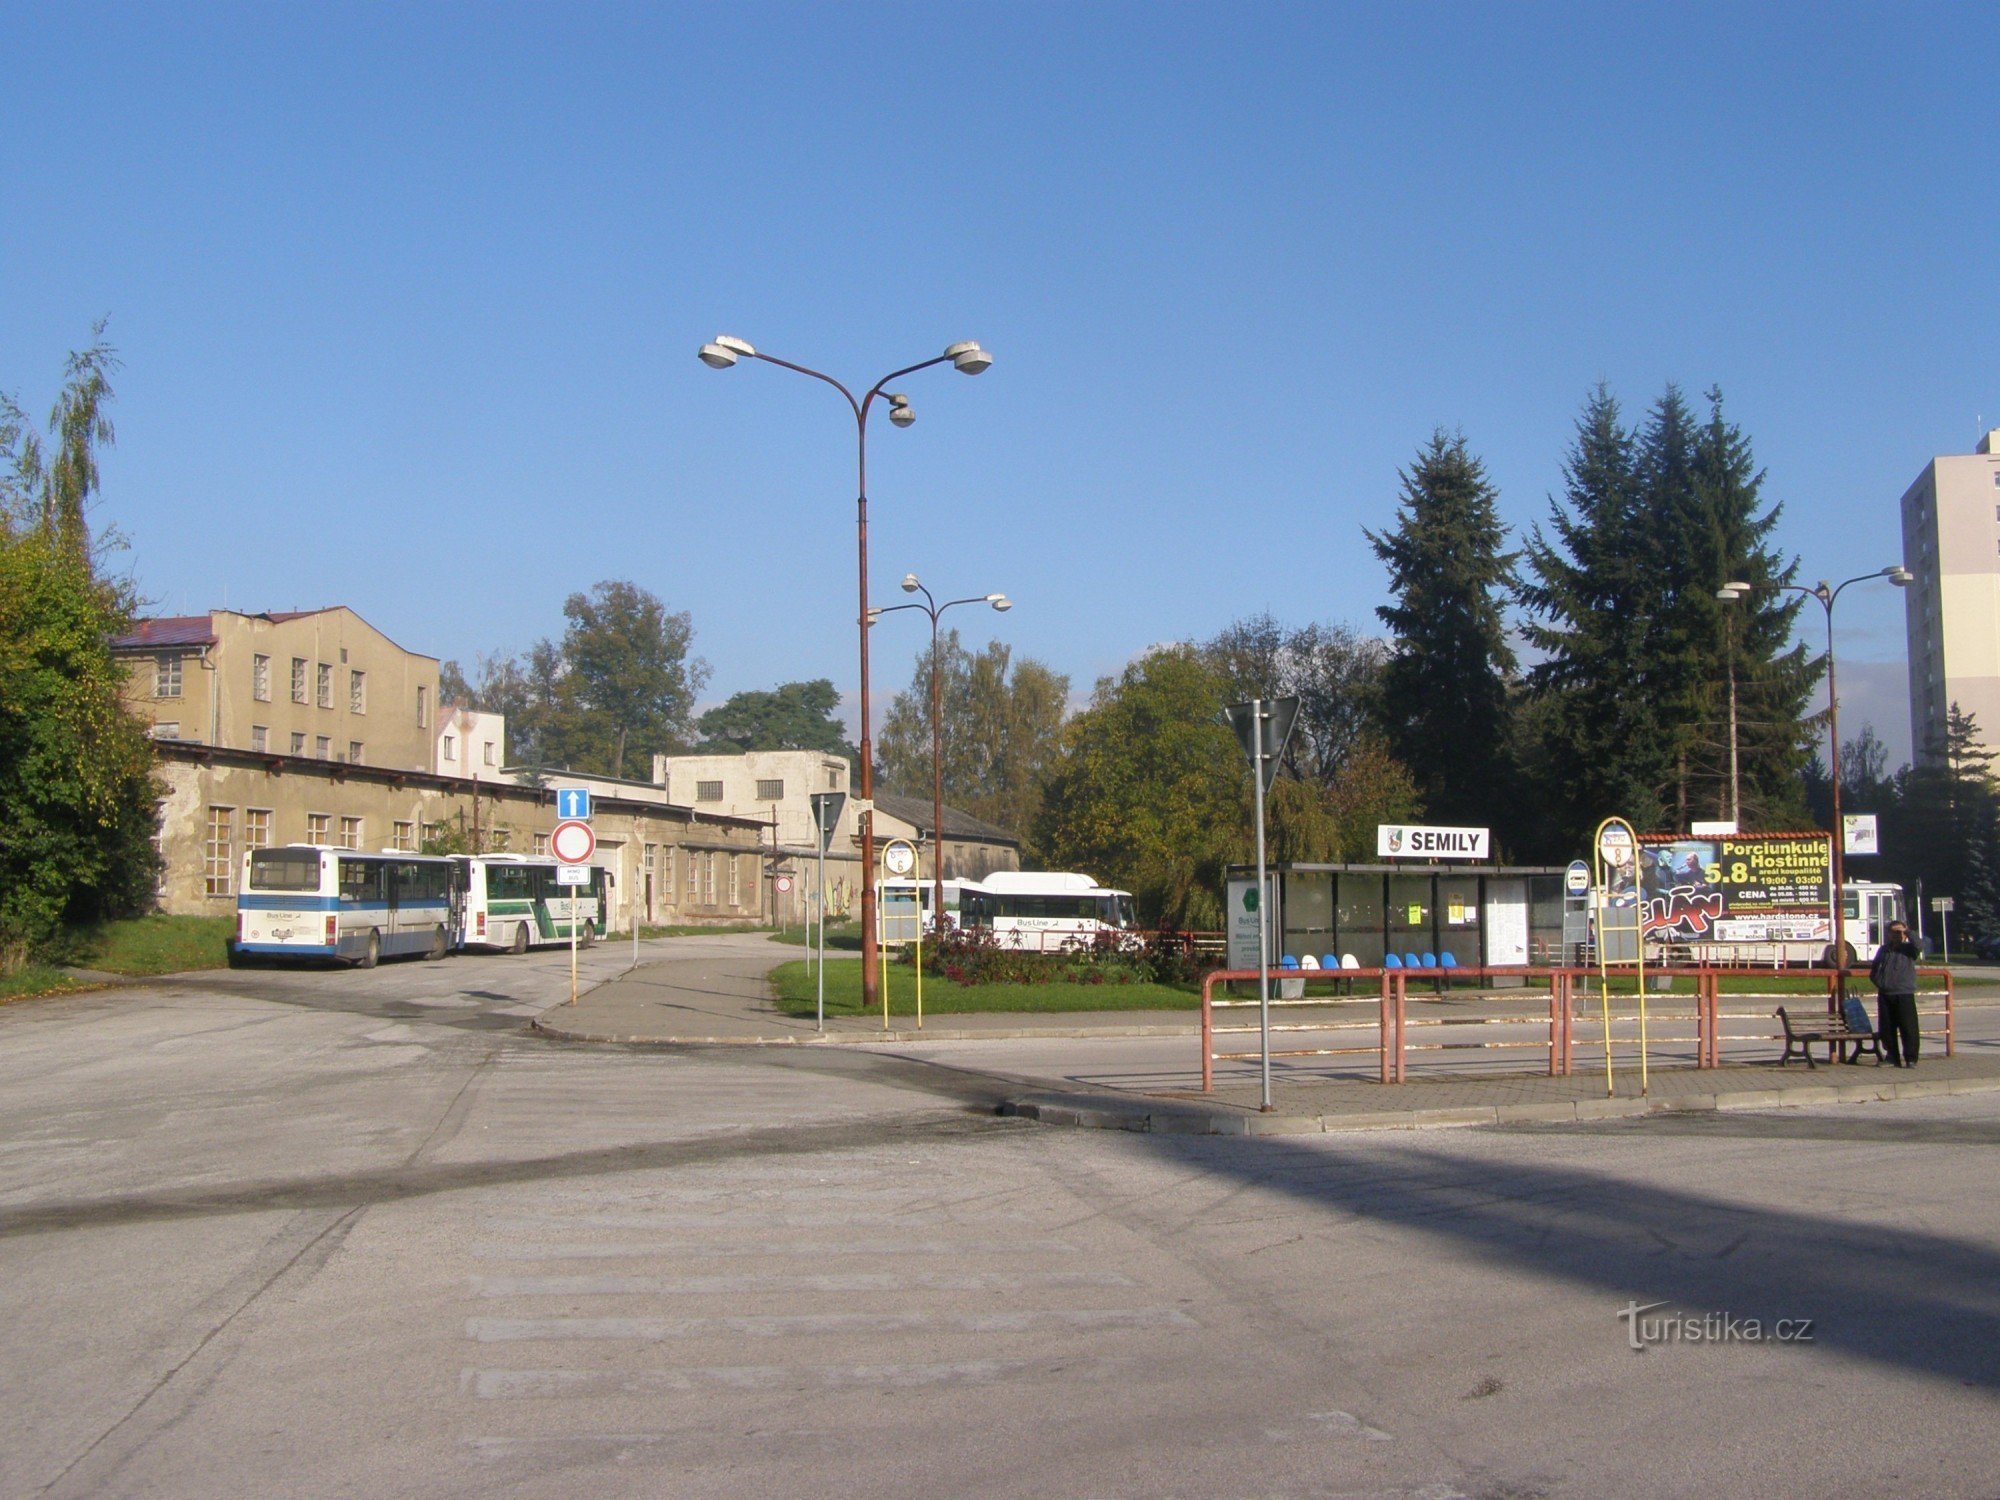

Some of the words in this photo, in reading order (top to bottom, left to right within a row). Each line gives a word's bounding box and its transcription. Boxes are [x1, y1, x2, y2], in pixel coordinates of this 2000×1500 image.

[1411, 831, 1481, 852] SEMILY
[1722, 841, 1828, 856] Porciunkule
[1615, 848, 1622, 862] 8
[1750, 853, 1829, 868] Hostinné
[897, 860, 904, 871] 6
[1780, 867, 1821, 876] koupaliště
[1703, 862, 1757, 884] 5.8.
[1760, 876, 1787, 885] 19:00
[1795, 876, 1823, 884] 03:00
[1738, 890, 1767, 899] CENA
